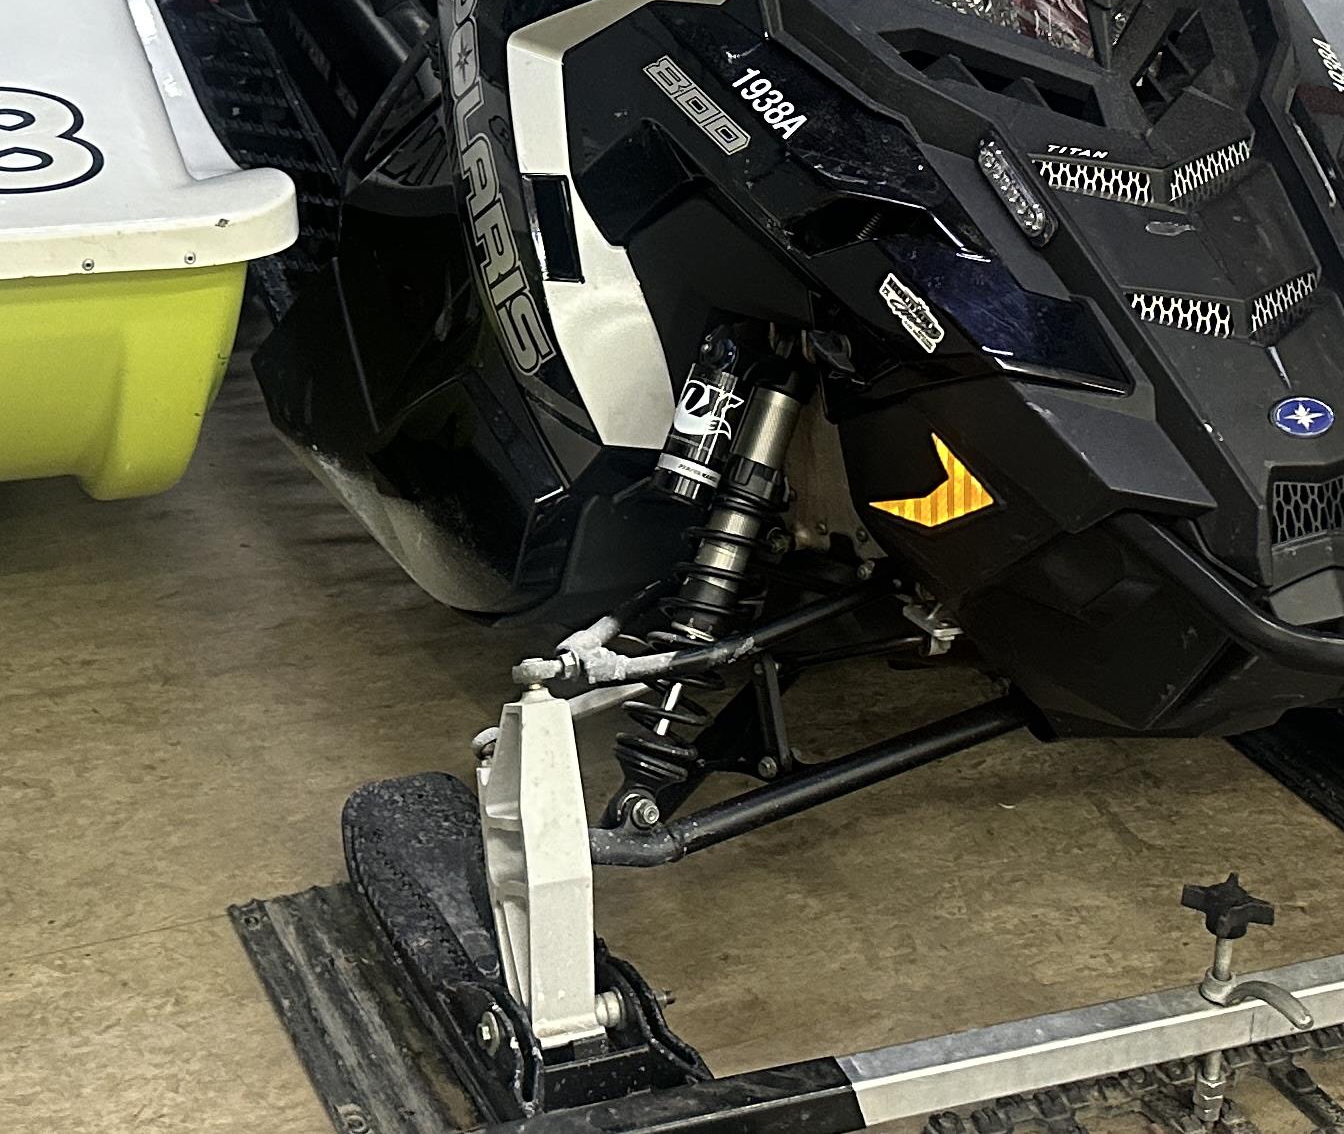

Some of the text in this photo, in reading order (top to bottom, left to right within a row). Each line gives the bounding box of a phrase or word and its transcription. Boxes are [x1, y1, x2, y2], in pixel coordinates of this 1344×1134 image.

[642, 54, 752, 156] 800
[731, 67, 808, 141] 1938A
[1047, 144, 1109, 159] TITAN
